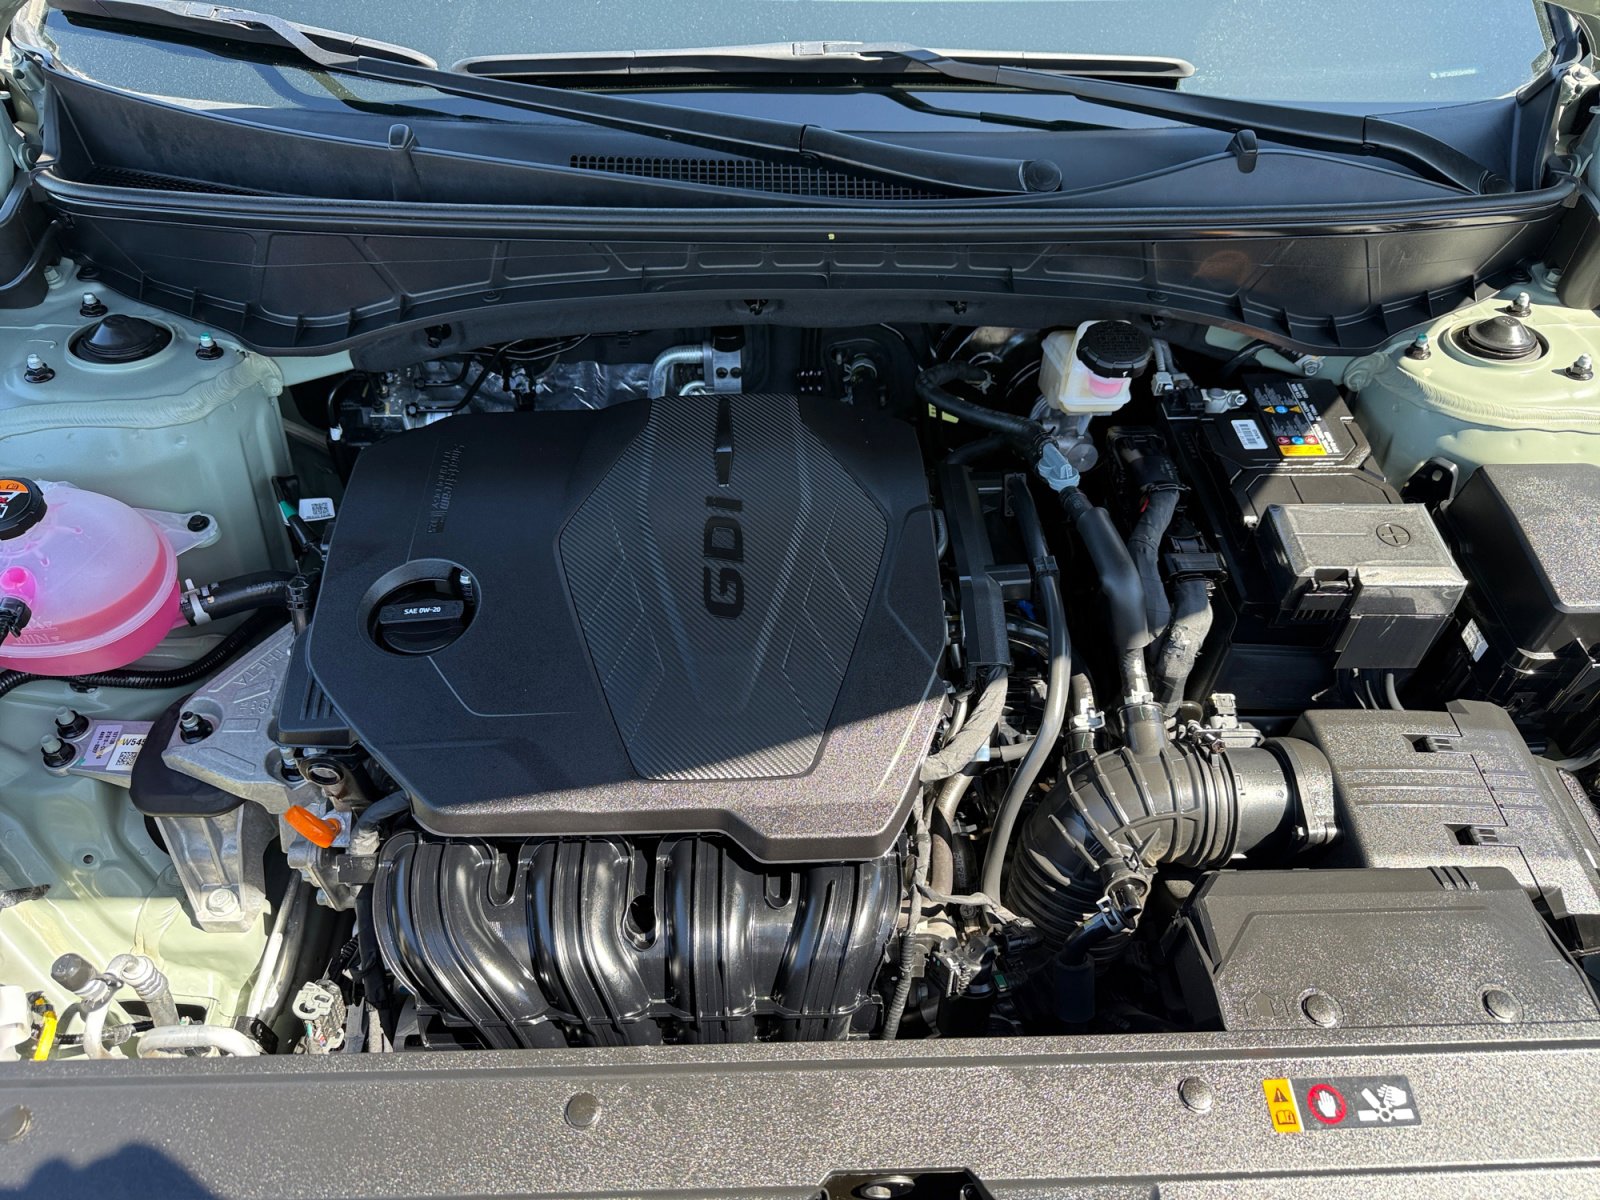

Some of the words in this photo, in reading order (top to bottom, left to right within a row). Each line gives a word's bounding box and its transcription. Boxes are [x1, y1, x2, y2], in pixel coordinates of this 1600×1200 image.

[403, 607, 418, 615] SAE
[419, 606, 442, 614] 0W-20
[232, 648, 286, 687] THETA
